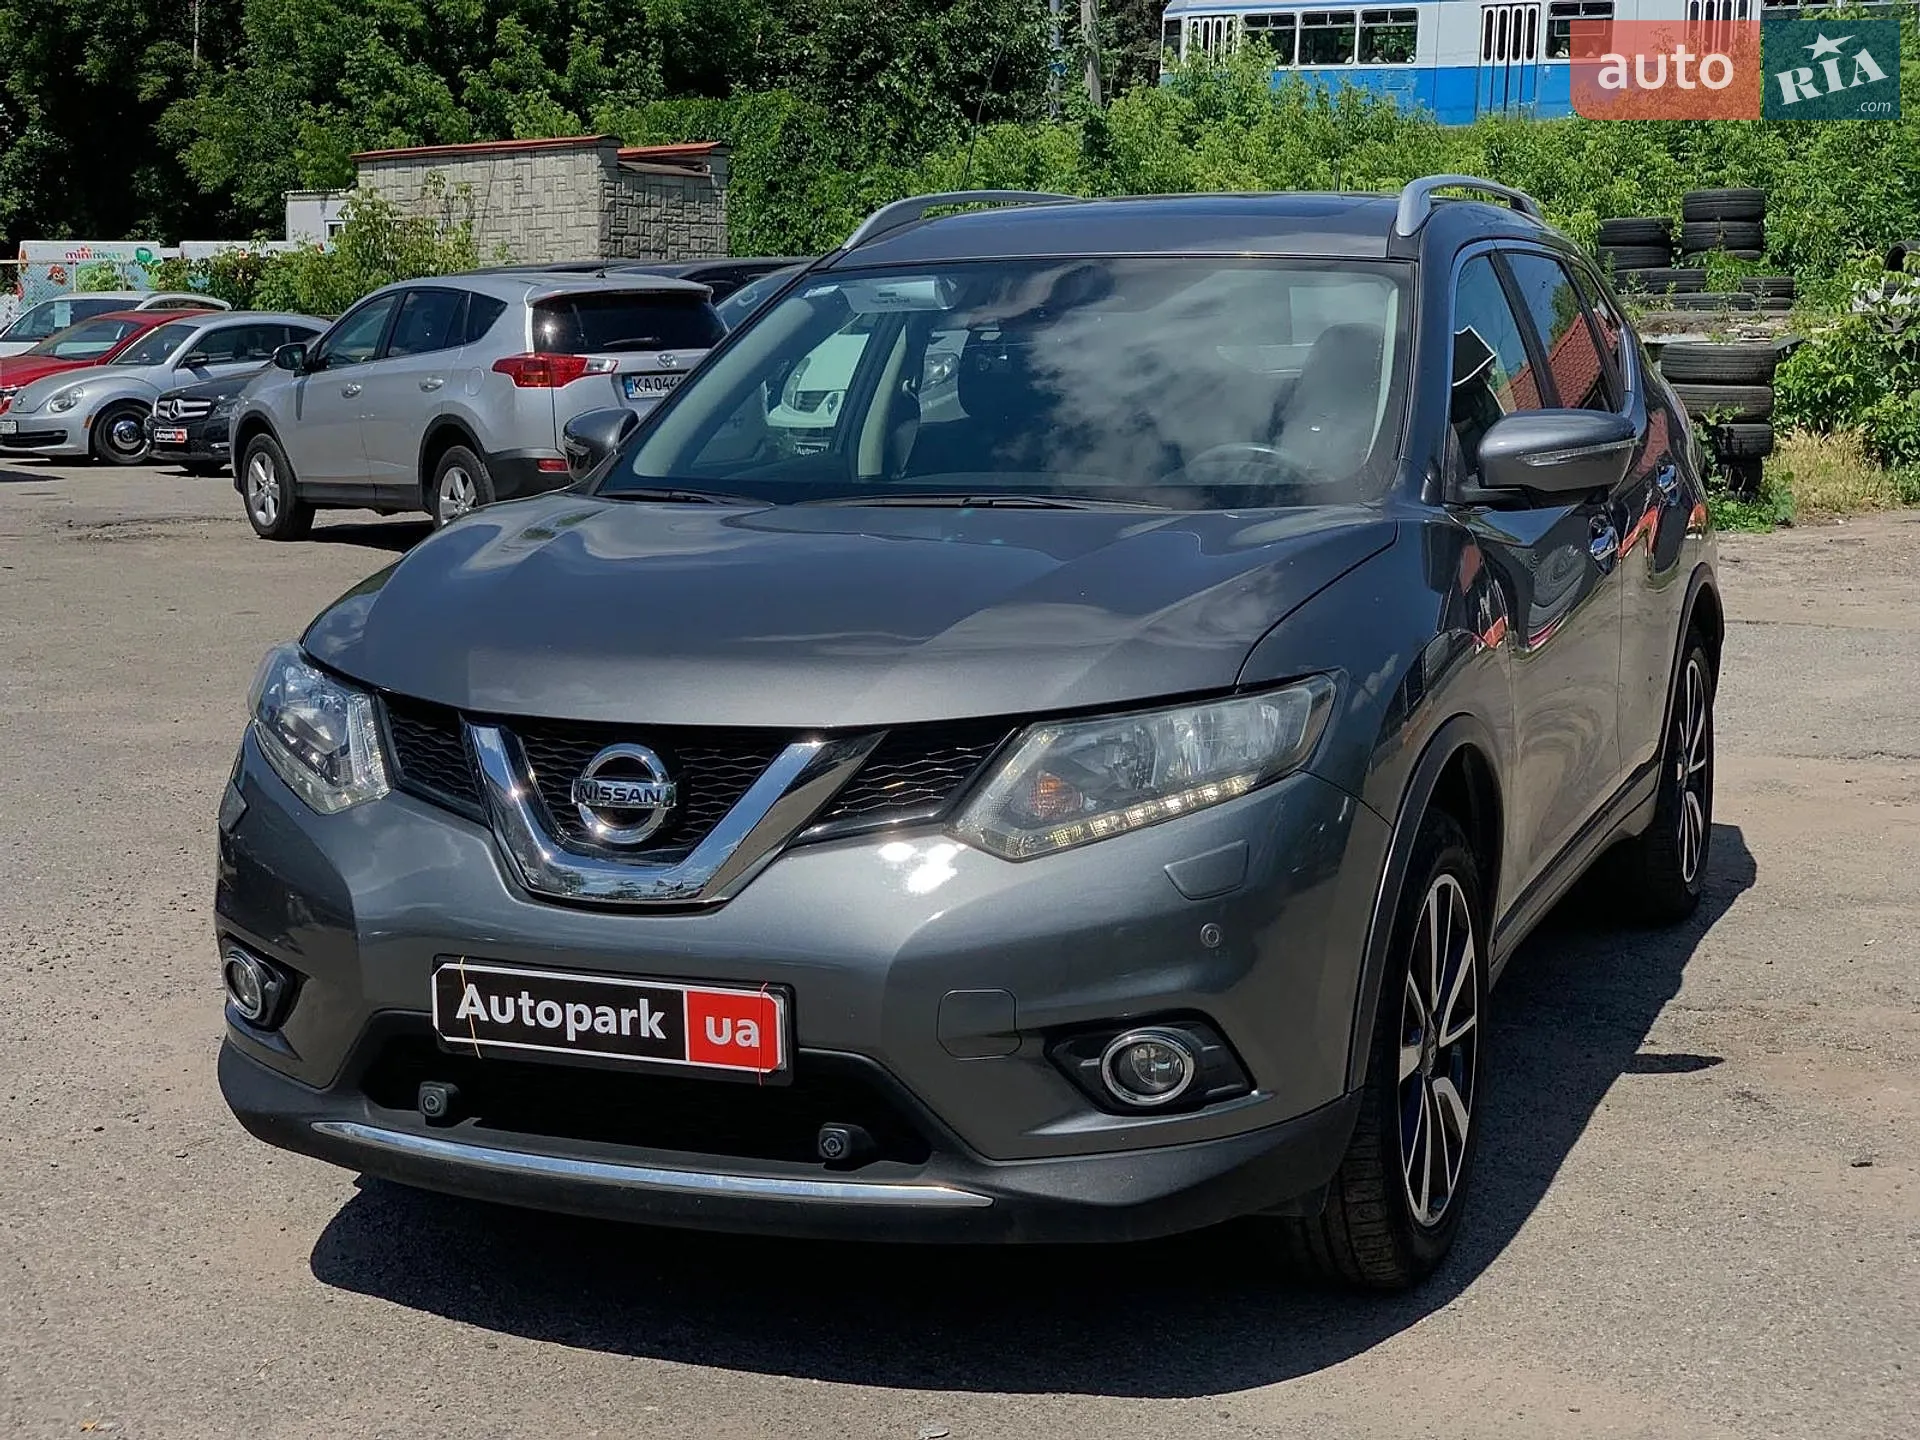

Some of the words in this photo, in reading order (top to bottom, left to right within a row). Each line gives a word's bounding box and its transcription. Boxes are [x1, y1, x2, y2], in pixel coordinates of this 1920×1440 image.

[579, 784, 661, 803] NISSAN
[455, 983, 667, 1042] Autopark
[705, 1015, 761, 1048] ua
